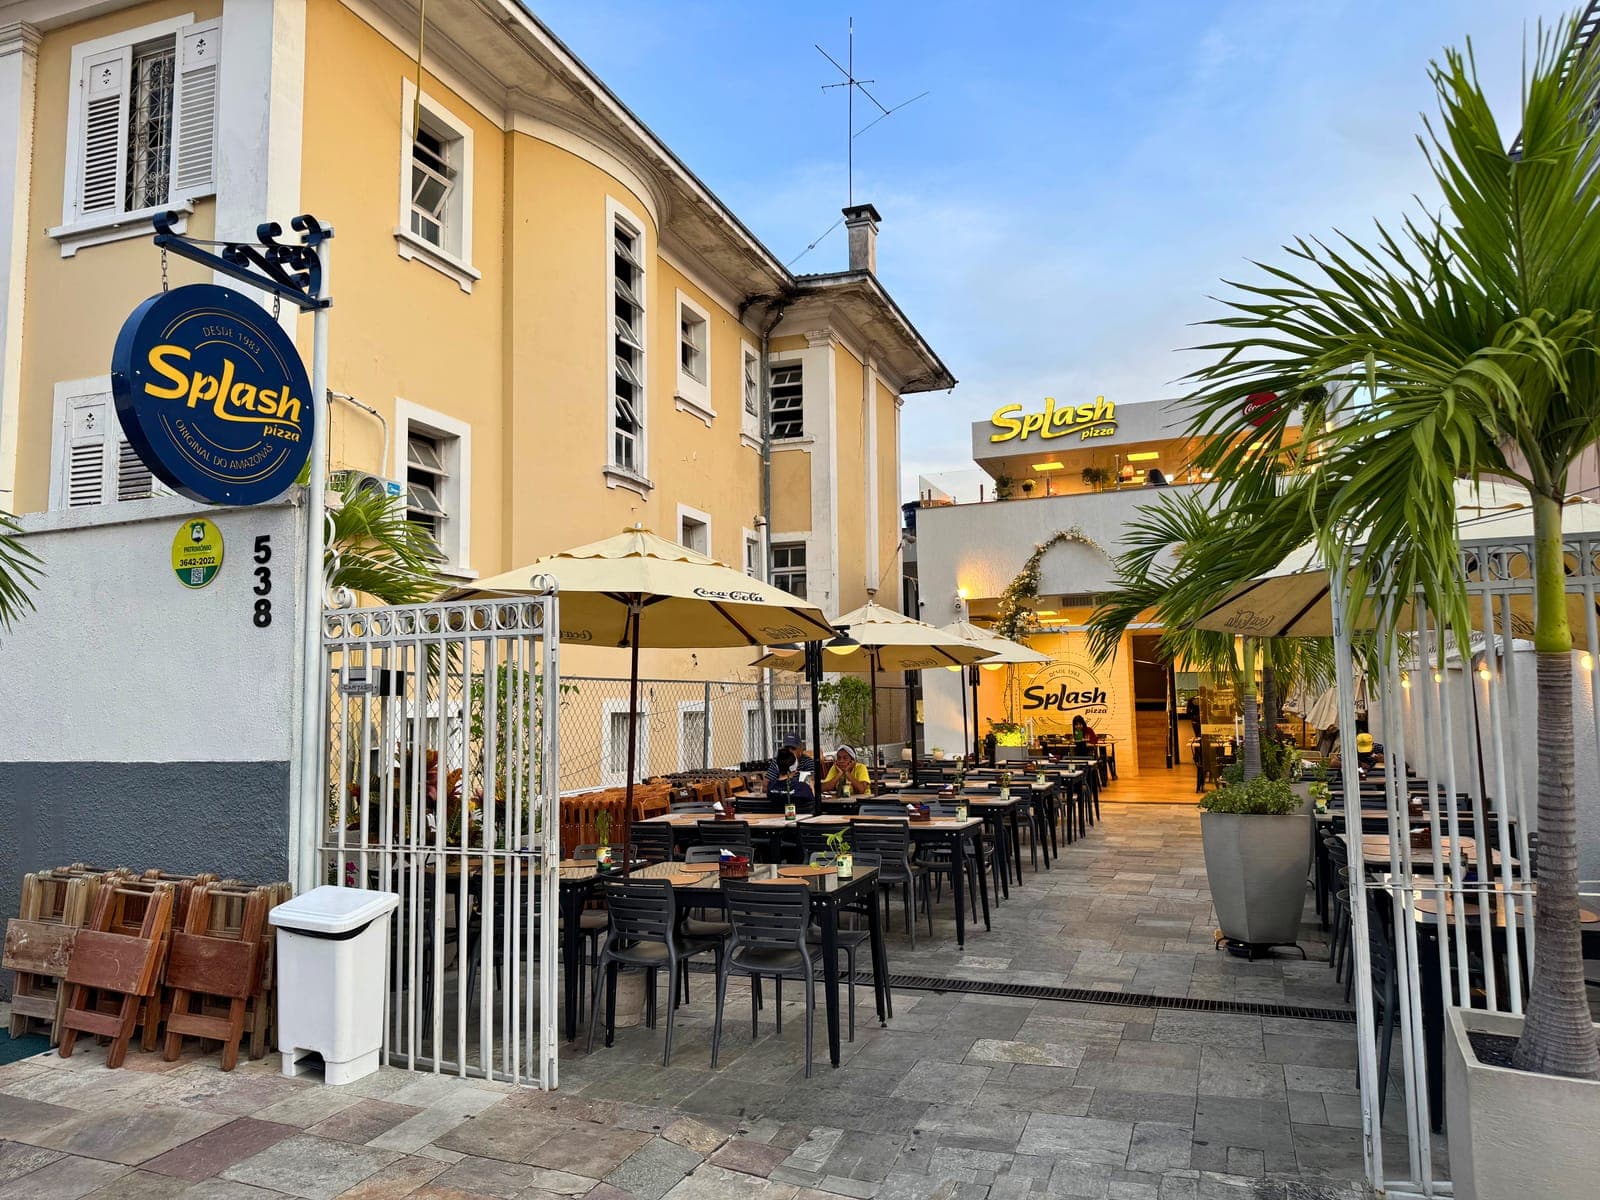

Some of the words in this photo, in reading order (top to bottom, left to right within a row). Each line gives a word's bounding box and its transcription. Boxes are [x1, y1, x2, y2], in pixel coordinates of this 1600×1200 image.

[202, 325, 233, 338] DESDE
[239, 333, 260, 354] 1983
[144, 344, 303, 433] Splash
[990, 394, 1119, 443] Splash
[175, 419, 211, 461] ORIGINAL
[213, 455, 228, 469] DO
[229, 443, 274, 470] AMAZONAS
[263, 423, 300, 443] pizza
[1080, 426, 1115, 441] pizza
[1023, 683, 1108, 711] Splash
[1085, 706, 1108, 715] pizza
